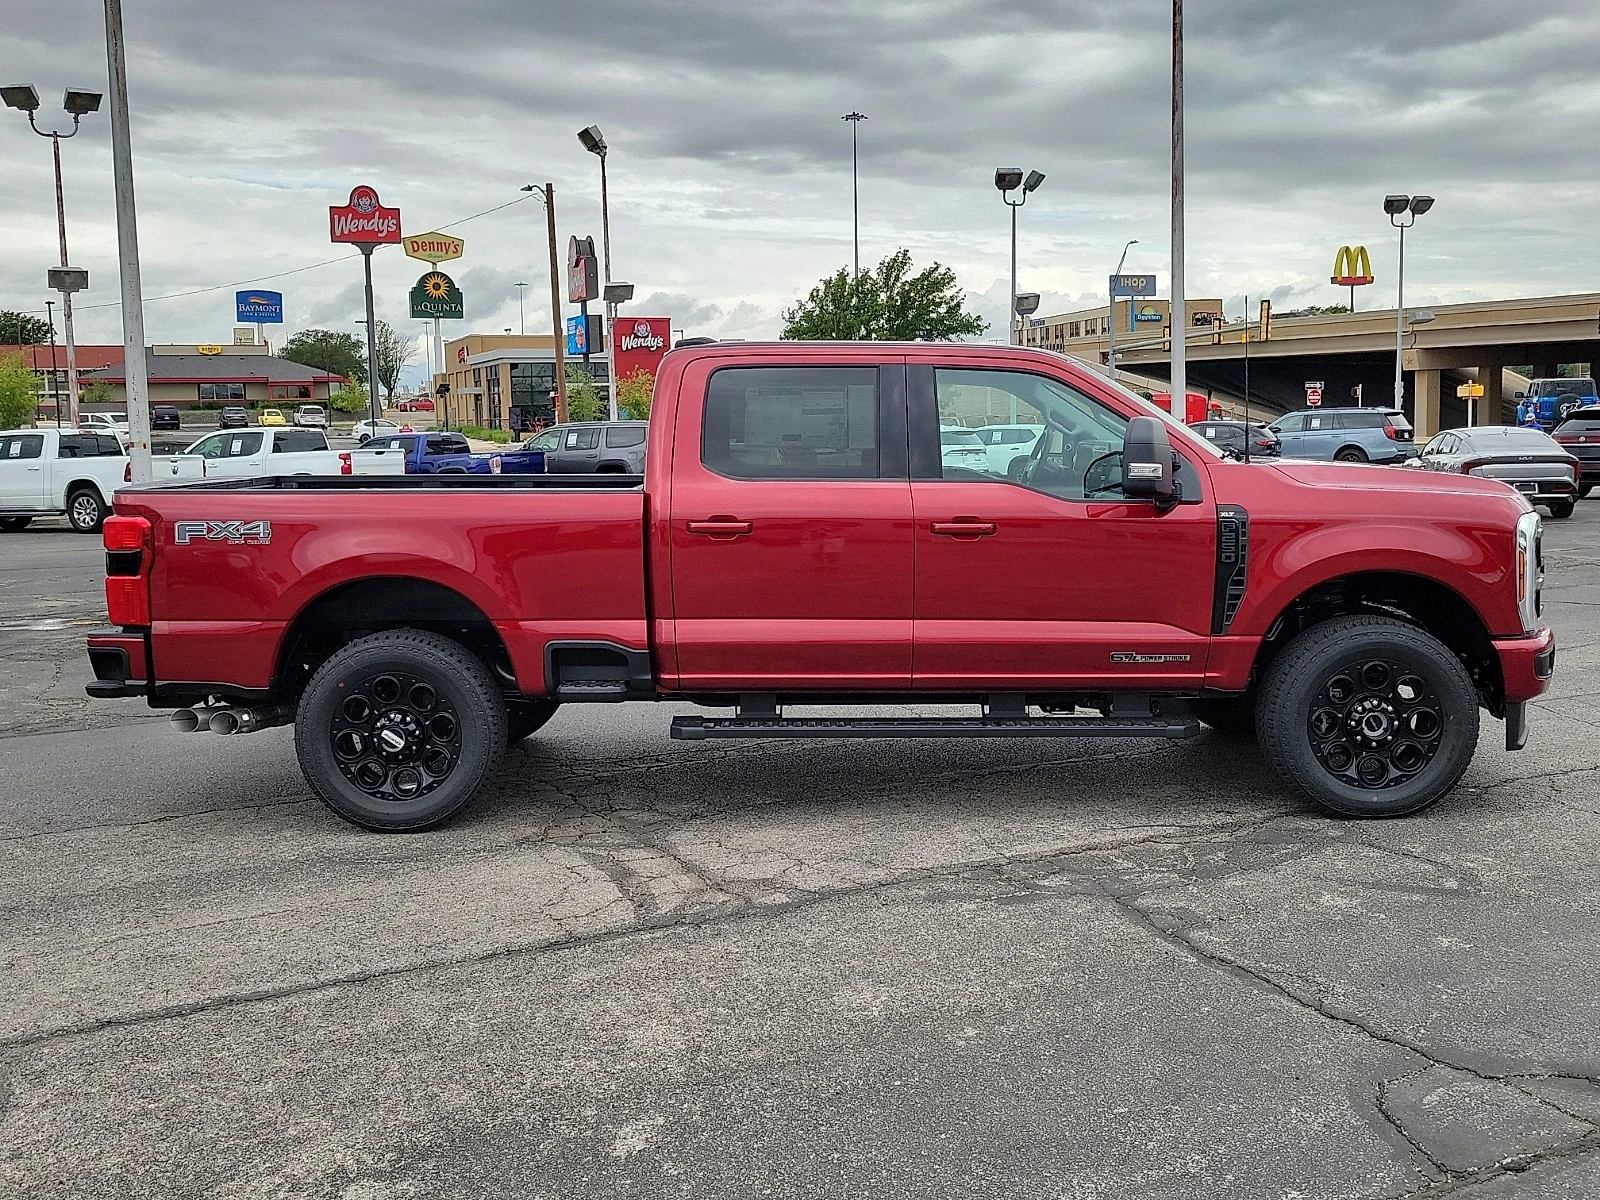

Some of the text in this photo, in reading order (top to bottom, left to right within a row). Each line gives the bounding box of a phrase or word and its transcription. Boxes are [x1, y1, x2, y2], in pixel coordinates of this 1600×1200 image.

[334, 211, 397, 237] Wendy's
[410, 240, 460, 255] Denny's
[239, 303, 281, 313] BAYMONT
[621, 332, 664, 351] Wendy's
[175, 520, 271, 545] FX4
